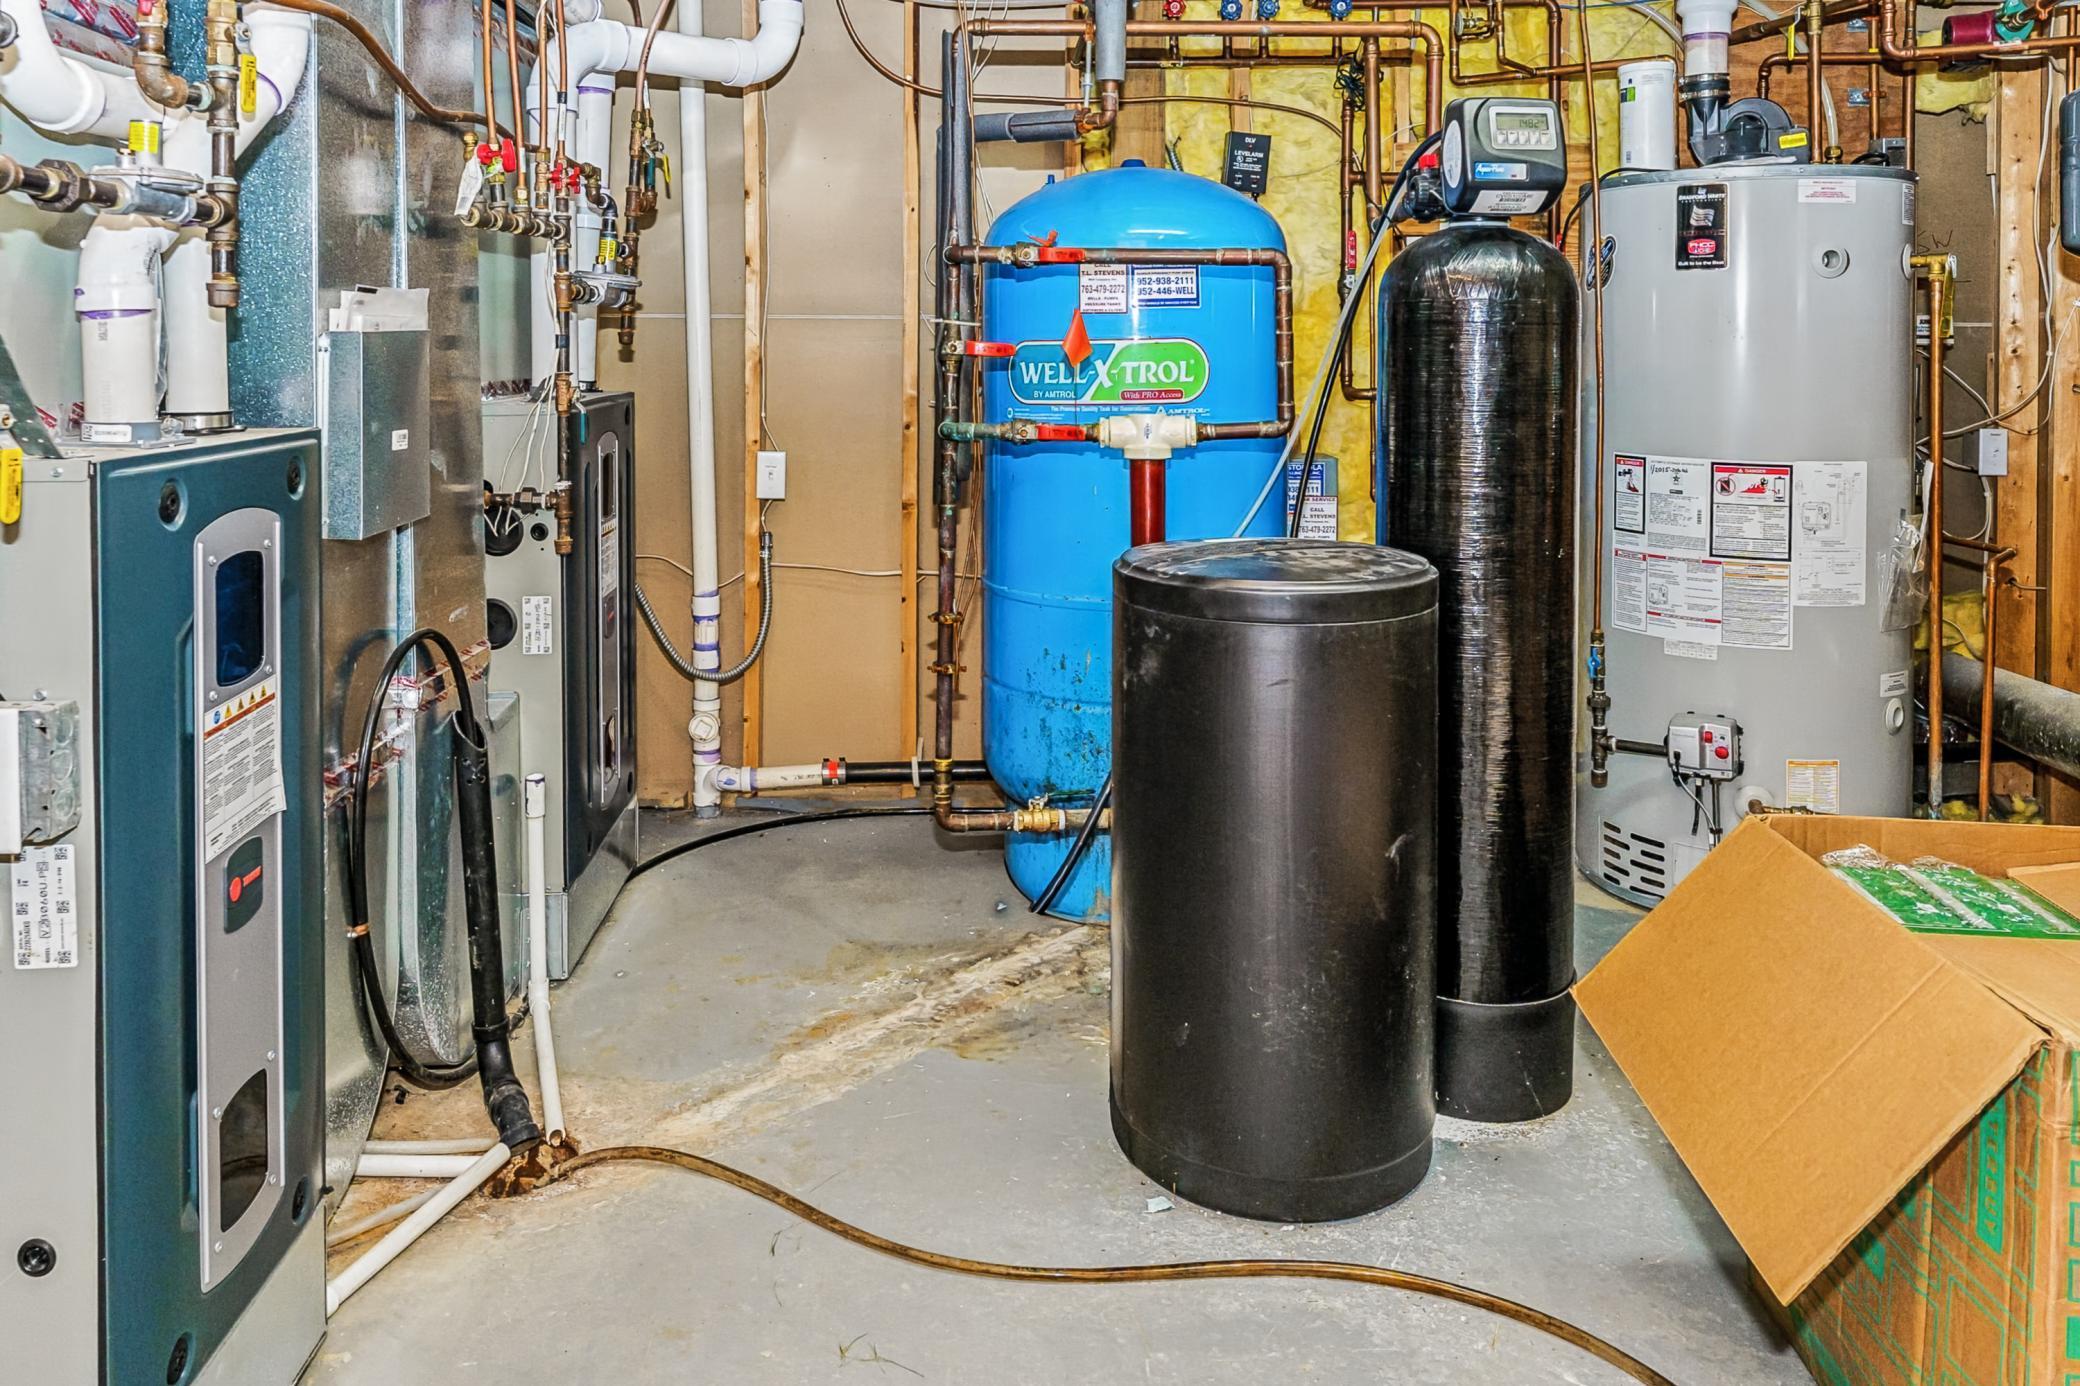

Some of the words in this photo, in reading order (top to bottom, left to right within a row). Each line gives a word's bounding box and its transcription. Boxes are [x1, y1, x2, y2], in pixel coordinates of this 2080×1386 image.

[1137, 276, 1194, 285] 952-938-2111
[1081, 285, 1125, 294] 763-479-2272
[1045, 391, 1076, 399] AMTROL
[1123, 391, 1140, 399] With
[1140, 391, 1160, 399] PRO
[1160, 391, 1182, 399] Access
